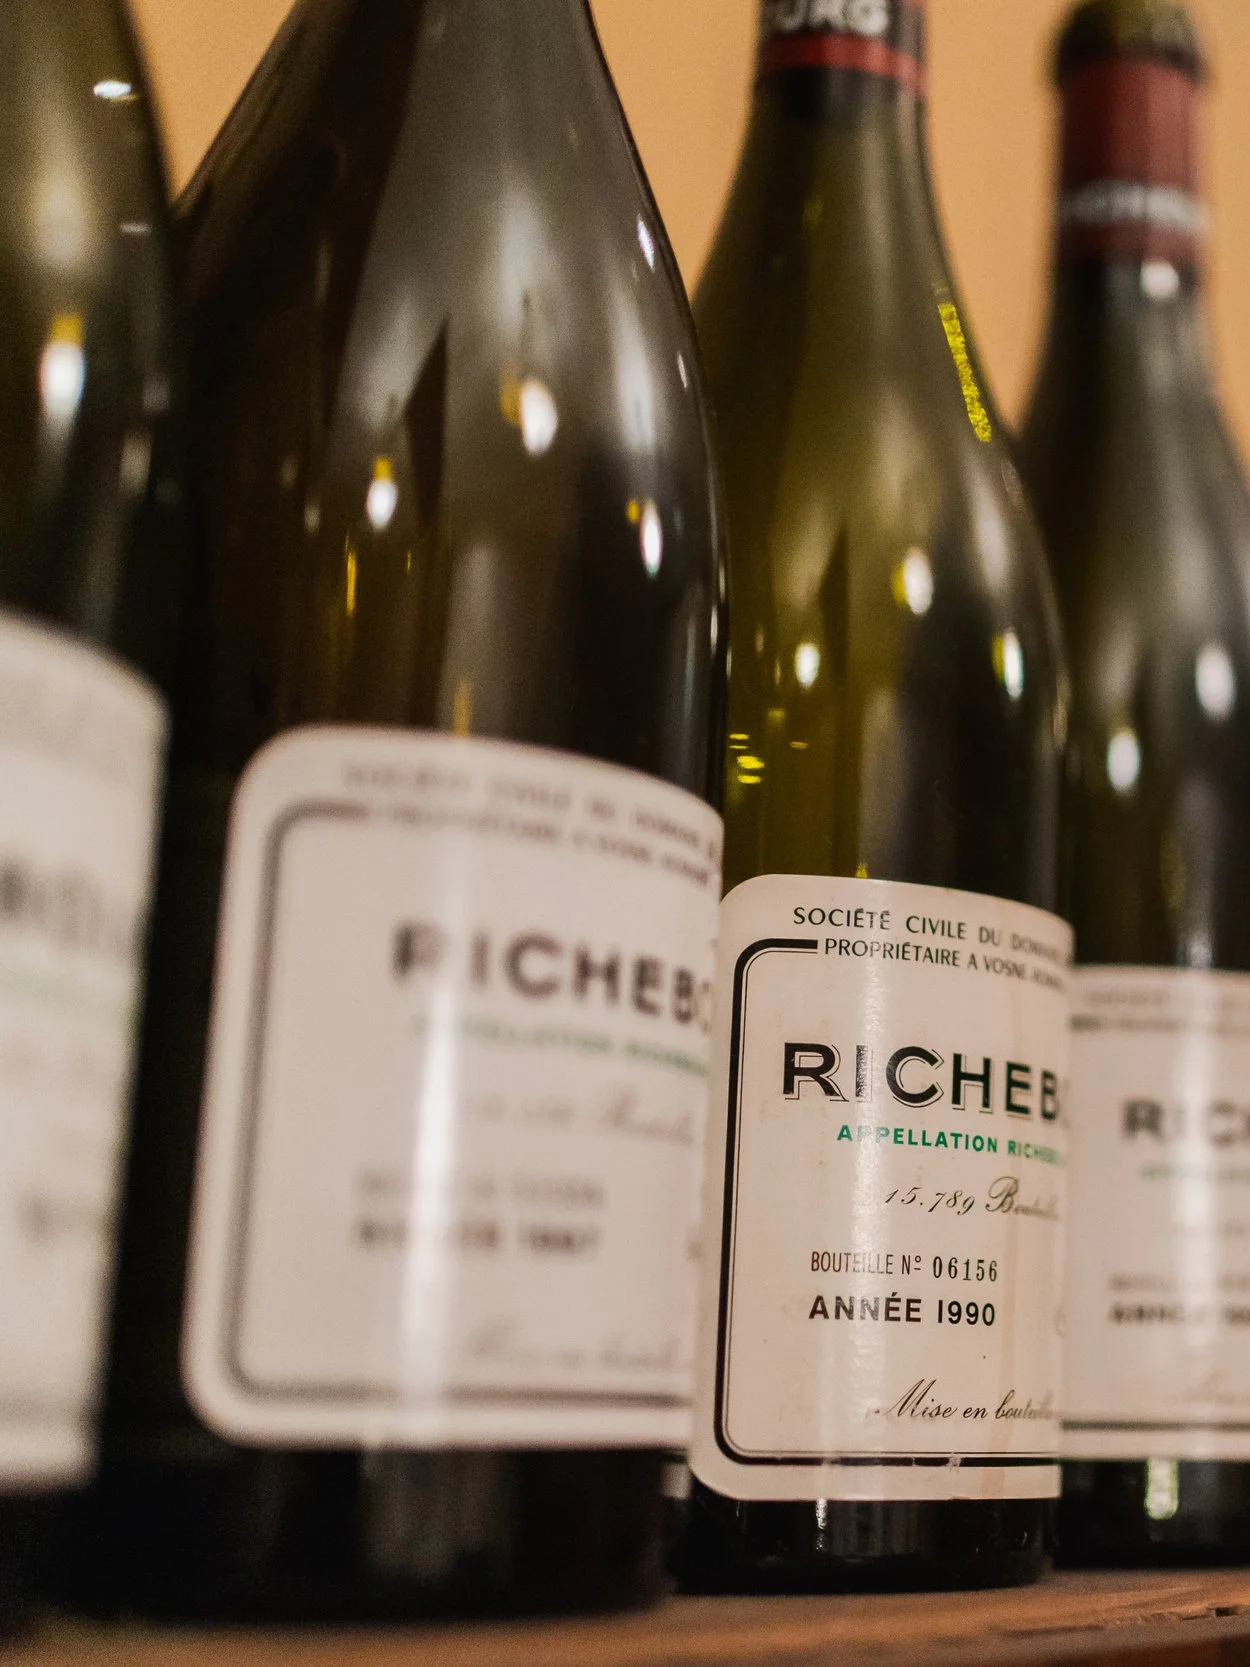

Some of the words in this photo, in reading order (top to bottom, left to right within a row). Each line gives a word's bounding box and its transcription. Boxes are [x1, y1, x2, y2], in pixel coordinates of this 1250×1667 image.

[793, 907, 890, 930] SOCIÉTÉ
[906, 915, 967, 940] CIVILE
[979, 926, 1001, 947] DU
[825, 938, 960, 967] PROPRIÉTAIRE
[837, 1124, 999, 1152] APPELLATION
[884, 1186, 976, 1216] 15.789
[811, 1251, 894, 1275] BOUTEILLE
[933, 1256, 998, 1282] 06156
[808, 1292, 922, 1323] ANNÉE
[938, 1299, 996, 1326] 1990
[962, 1404, 988, 1419] en
